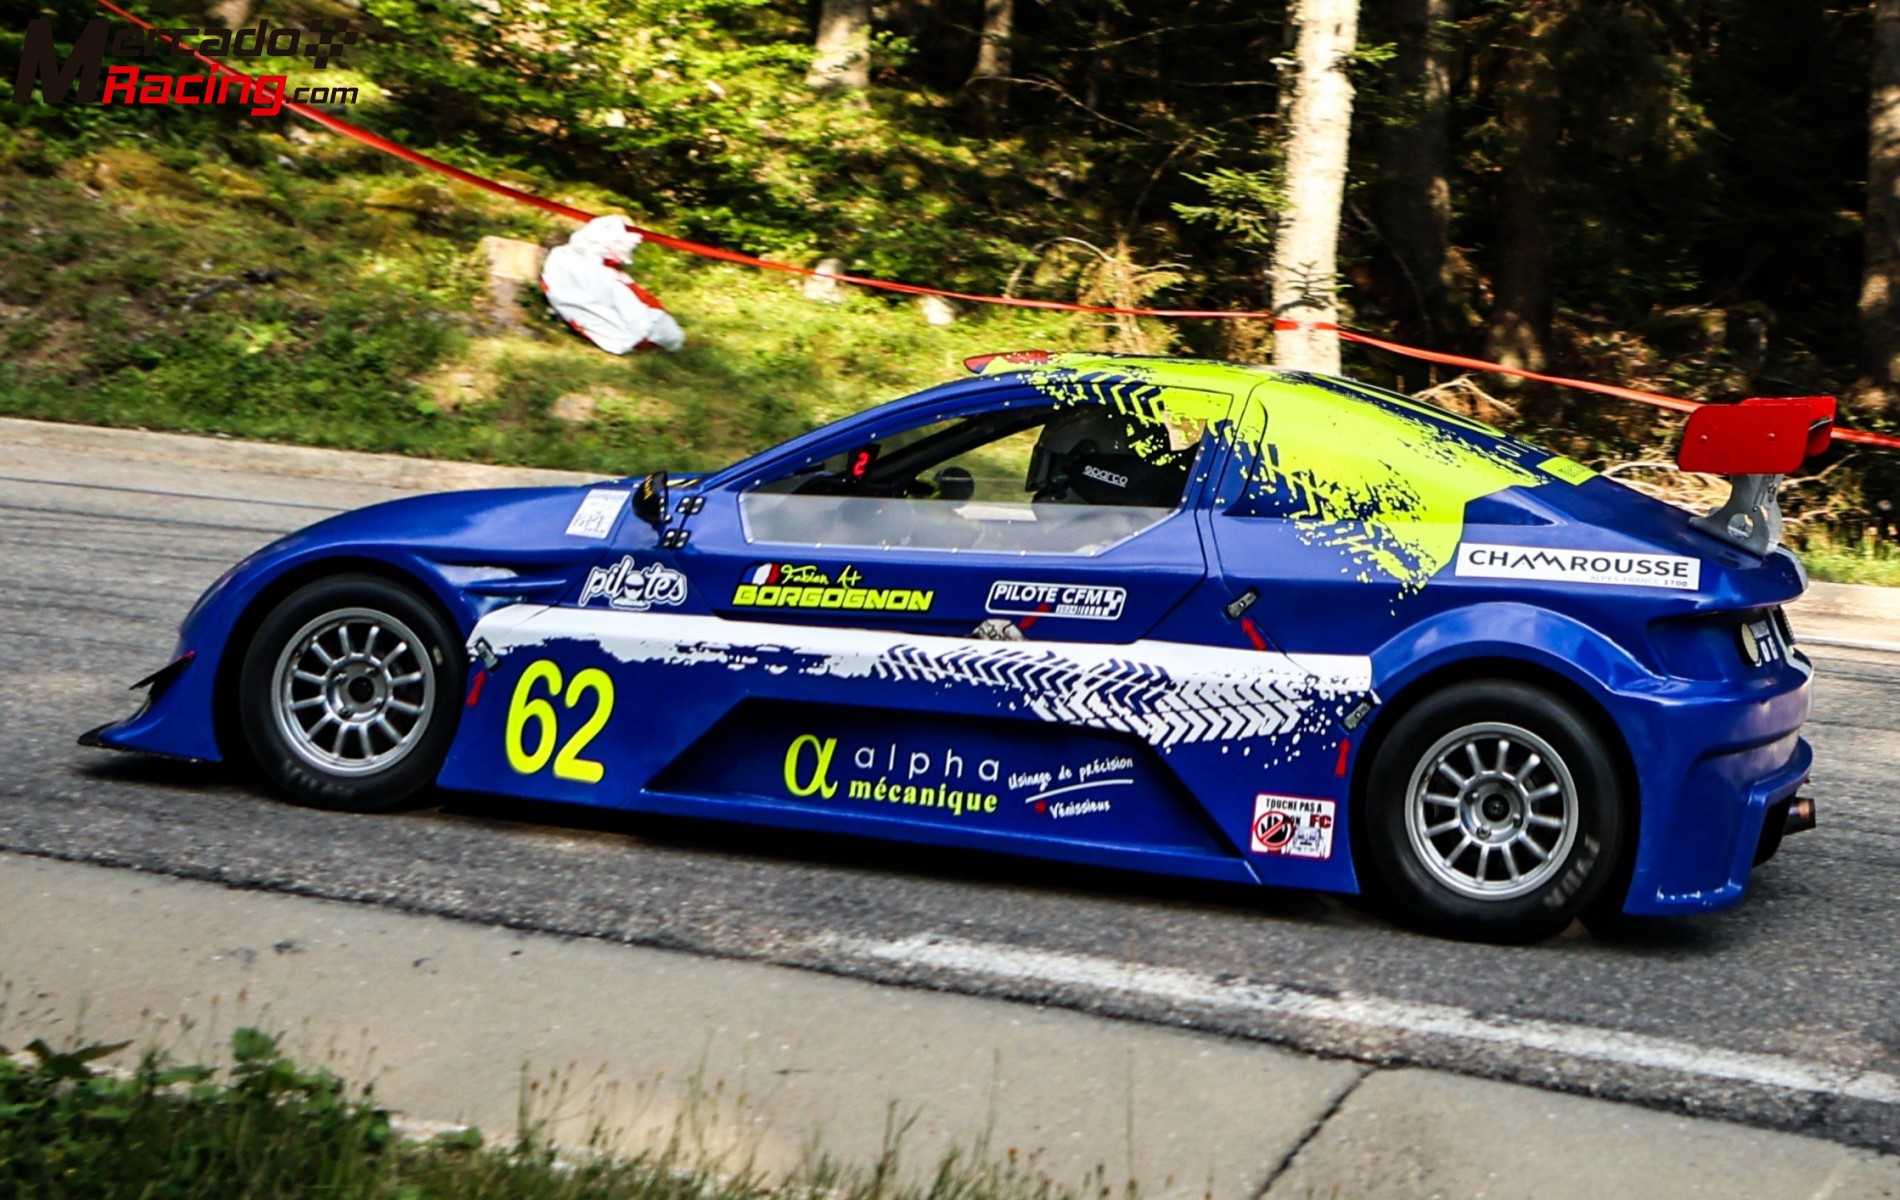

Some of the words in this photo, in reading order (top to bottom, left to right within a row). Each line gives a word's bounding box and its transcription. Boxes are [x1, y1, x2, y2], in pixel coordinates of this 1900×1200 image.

[1084, 465, 1128, 487] sparco
[1468, 549, 1689, 578] CHAMROUSSE
[993, 585, 1059, 603] PILOTE
[1062, 588, 1105, 605] CFM
[1664, 579, 1688, 587] 1700
[732, 585, 934, 611] BORGOGNON
[505, 659, 614, 784] 62
[854, 743, 1000, 782] alpha
[1008, 772, 1052, 792] Usinage
[1058, 765, 1073, 781] de
[849, 776, 999, 816] mécanique
[1266, 798, 1298, 811] TOUCHE
[1300, 801, 1316, 813] PAS
[1309, 813, 1332, 829] FC
